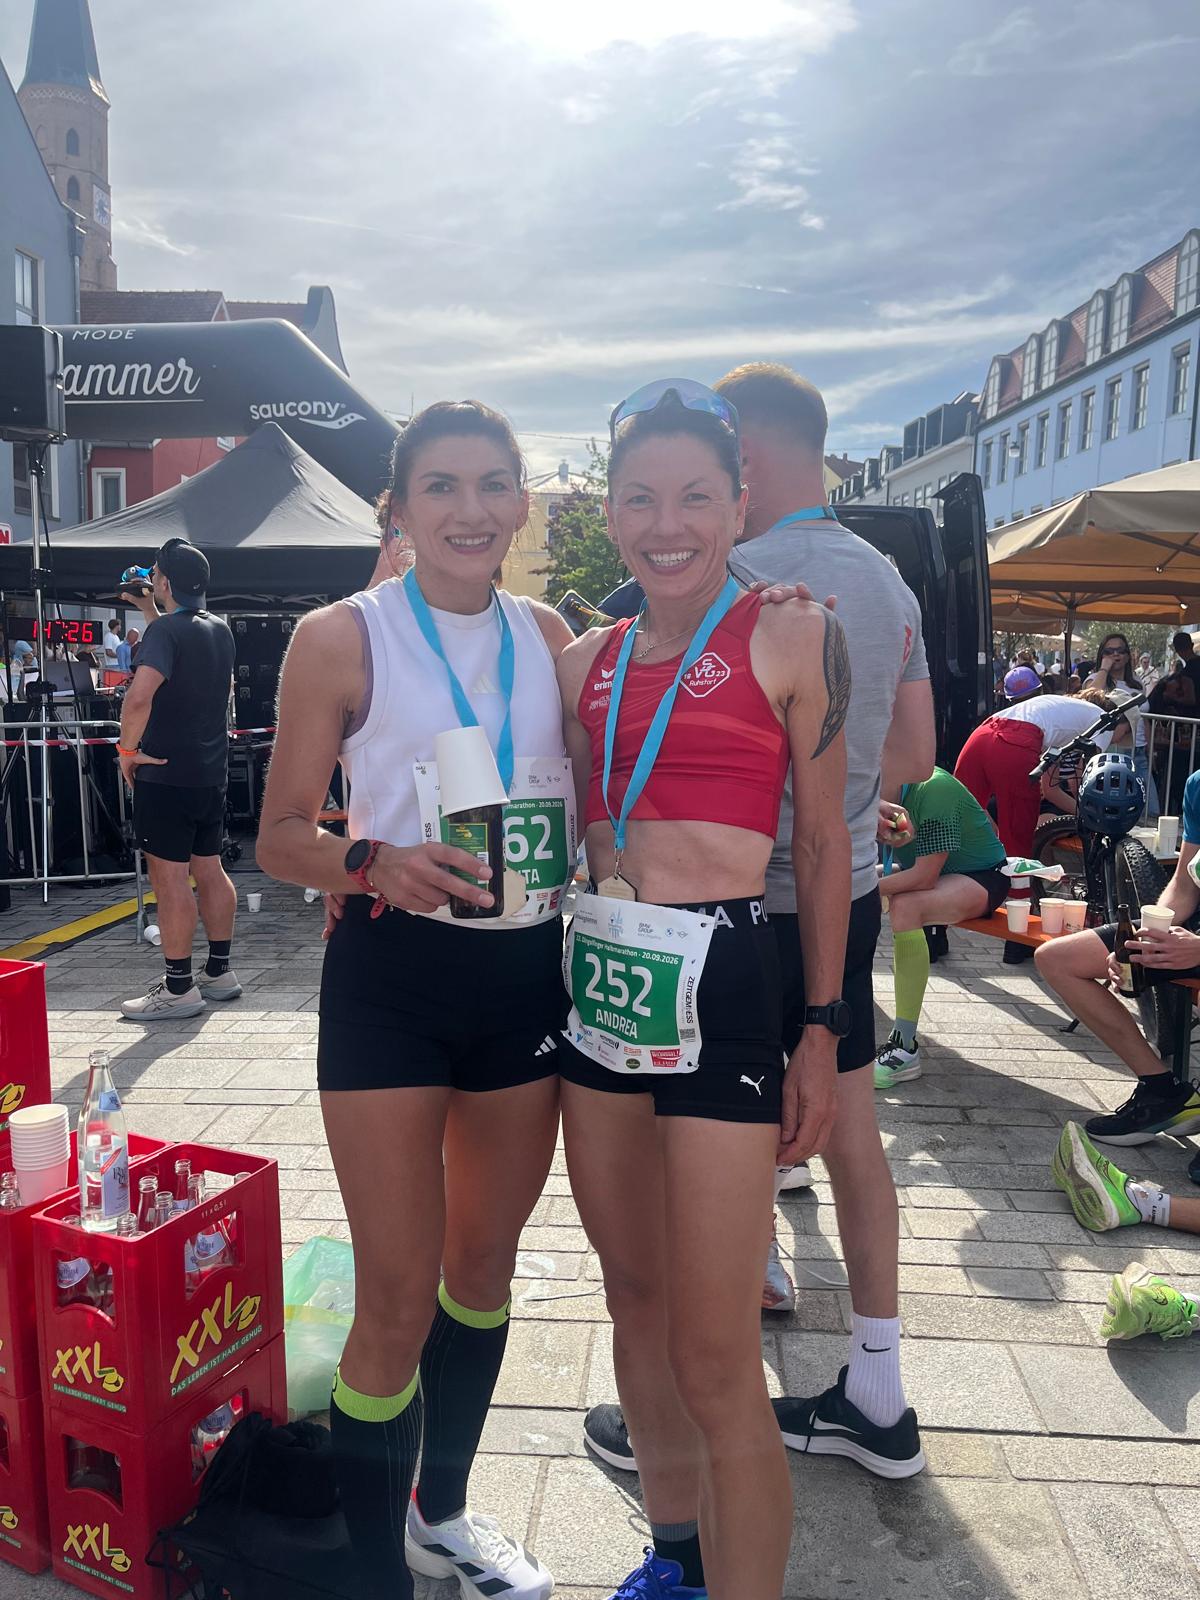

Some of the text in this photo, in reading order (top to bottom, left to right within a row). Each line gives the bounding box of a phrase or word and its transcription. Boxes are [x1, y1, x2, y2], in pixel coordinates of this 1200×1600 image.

[72, 329, 137, 341] MODE
[63, 358, 201, 396] ammer
[250, 401, 340, 420] saucony
[594, 680, 614, 691] erim
[503, 815, 554, 863] 62
[642, 951, 679, 965] 20.09.2026
[585, 953, 653, 1017] 252
[595, 1008, 638, 1039] ANDREA
[169, 1281, 250, 1384] XXL
[52, 1341, 117, 1384] XXL
[171, 1324, 263, 1396] DAS LEBEN IST HART GENUG
[63, 1522, 125, 1561] XXL
